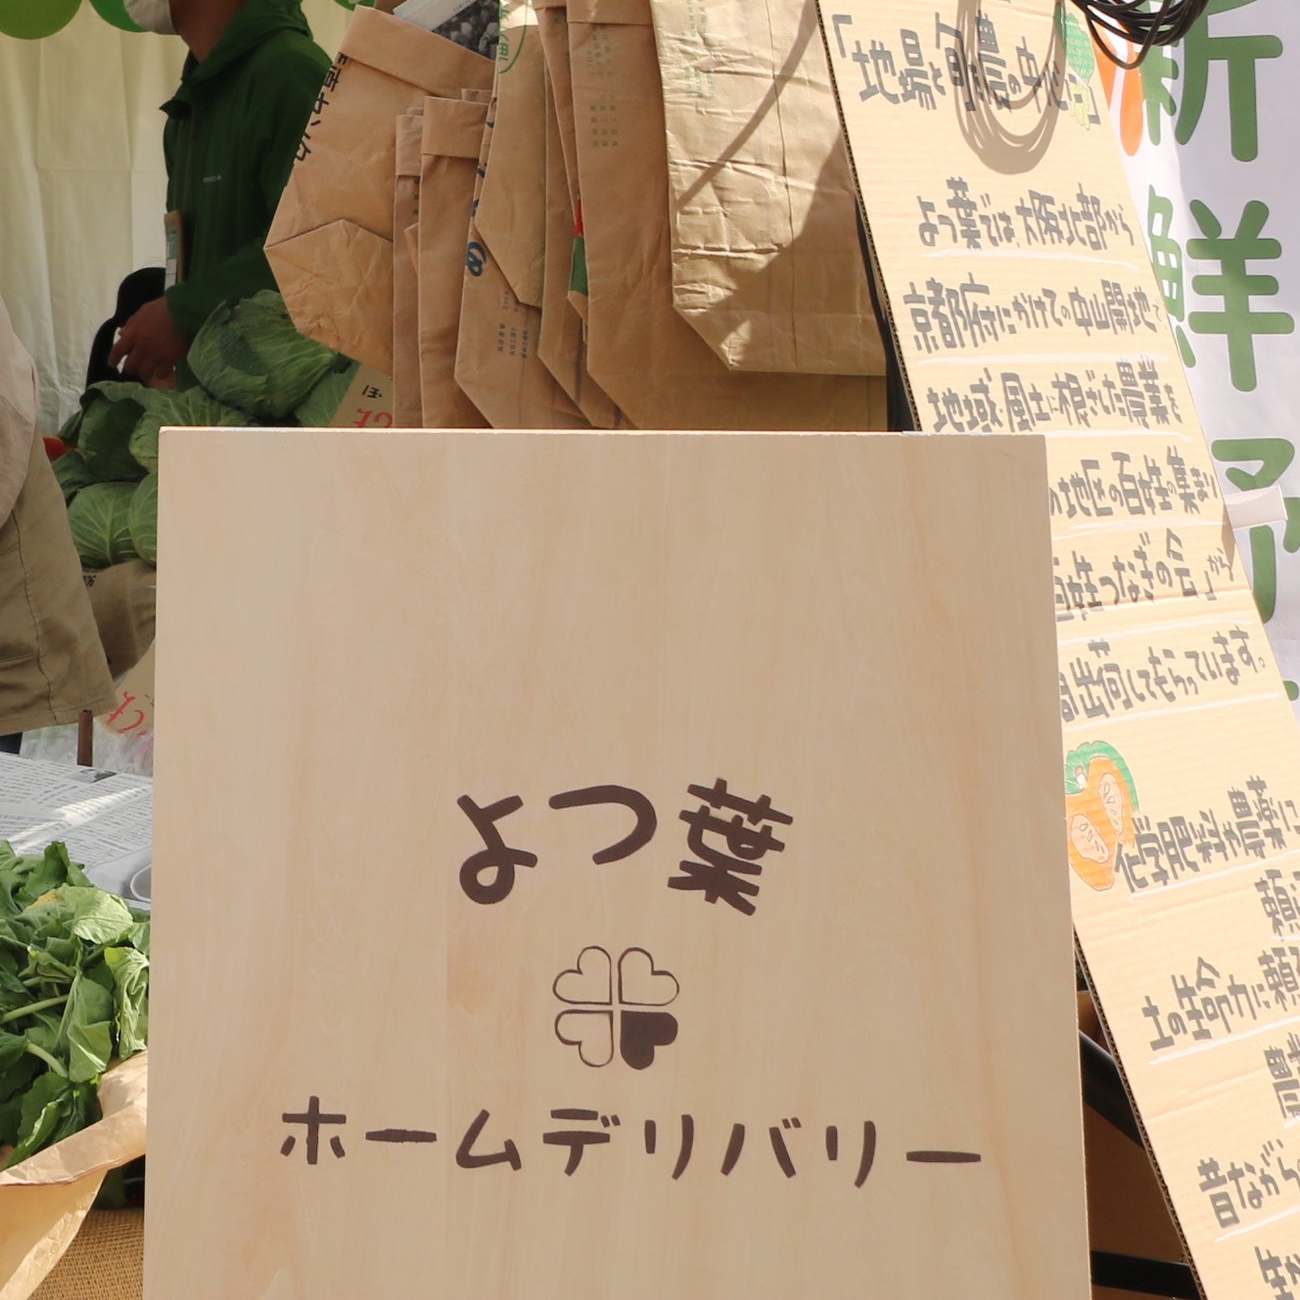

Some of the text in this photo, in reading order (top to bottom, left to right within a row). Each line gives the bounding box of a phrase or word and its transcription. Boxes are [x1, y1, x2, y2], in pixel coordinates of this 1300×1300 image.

[457, 776, 795, 917] よつ葉
[279, 1094, 983, 1190] ホームデリバリー
